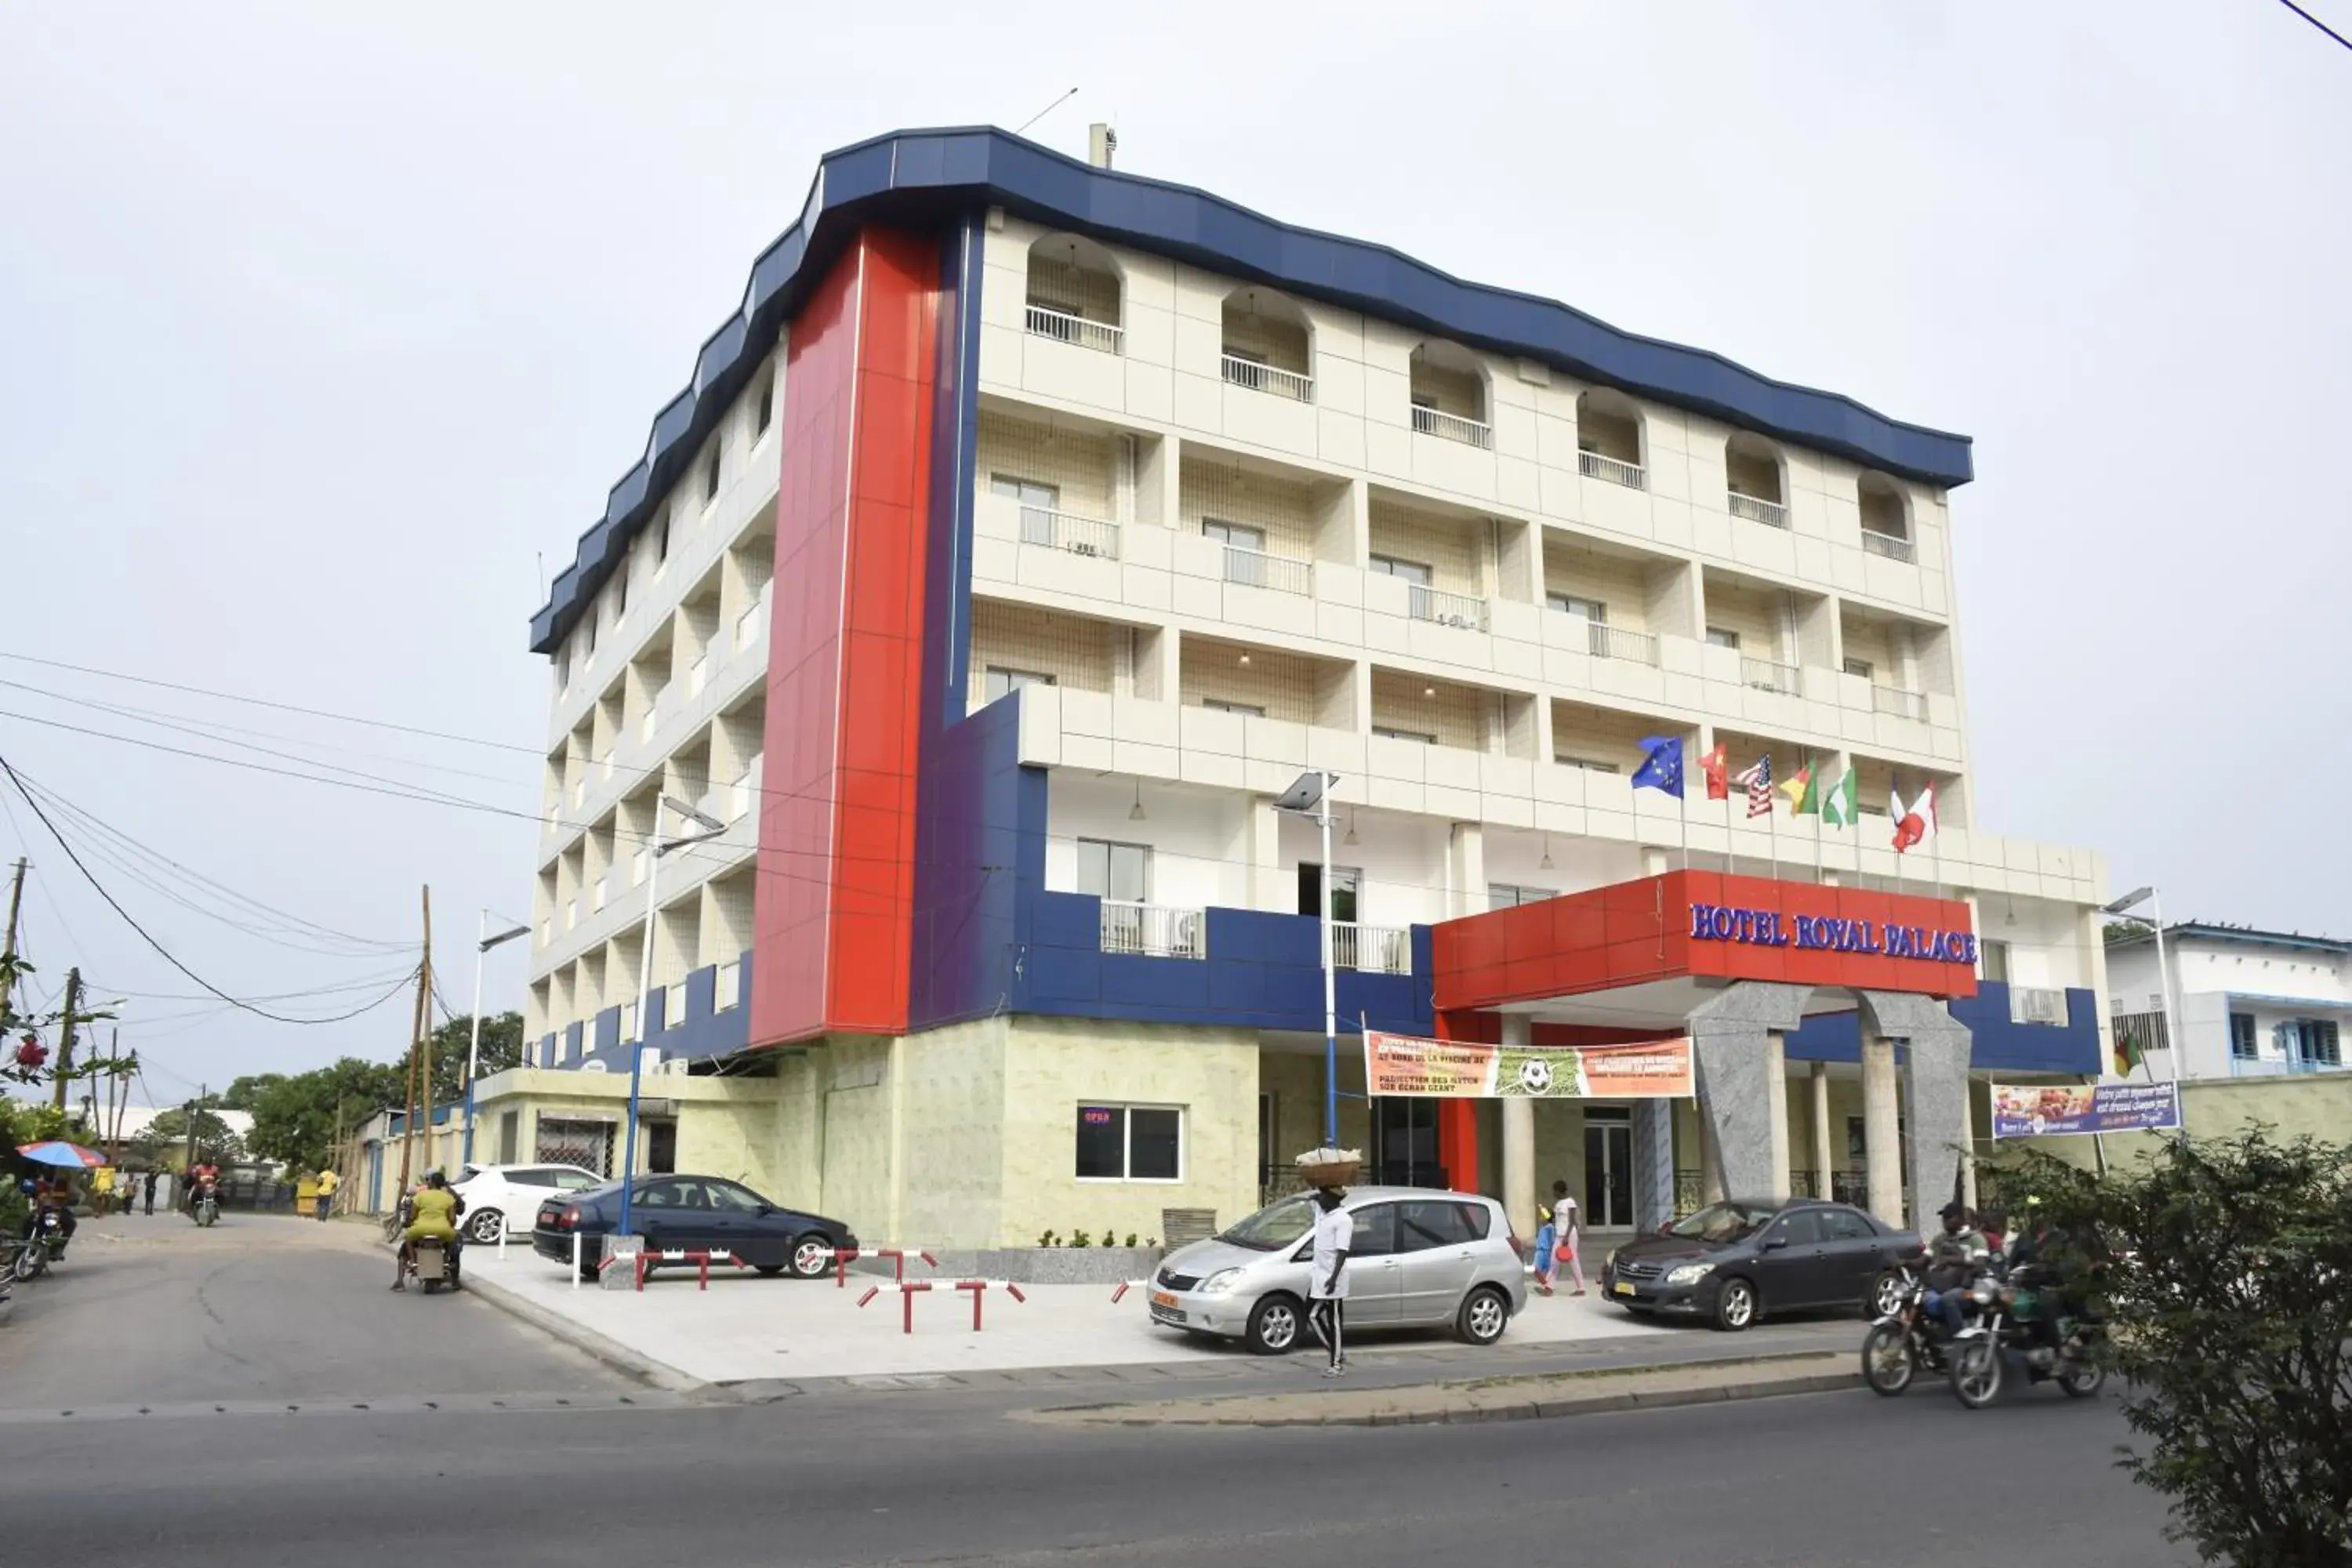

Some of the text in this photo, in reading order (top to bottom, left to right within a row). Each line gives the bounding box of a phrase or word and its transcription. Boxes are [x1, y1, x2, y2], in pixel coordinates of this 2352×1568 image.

[1690, 903, 1978, 964] HOTEL ROYAL PALACE
